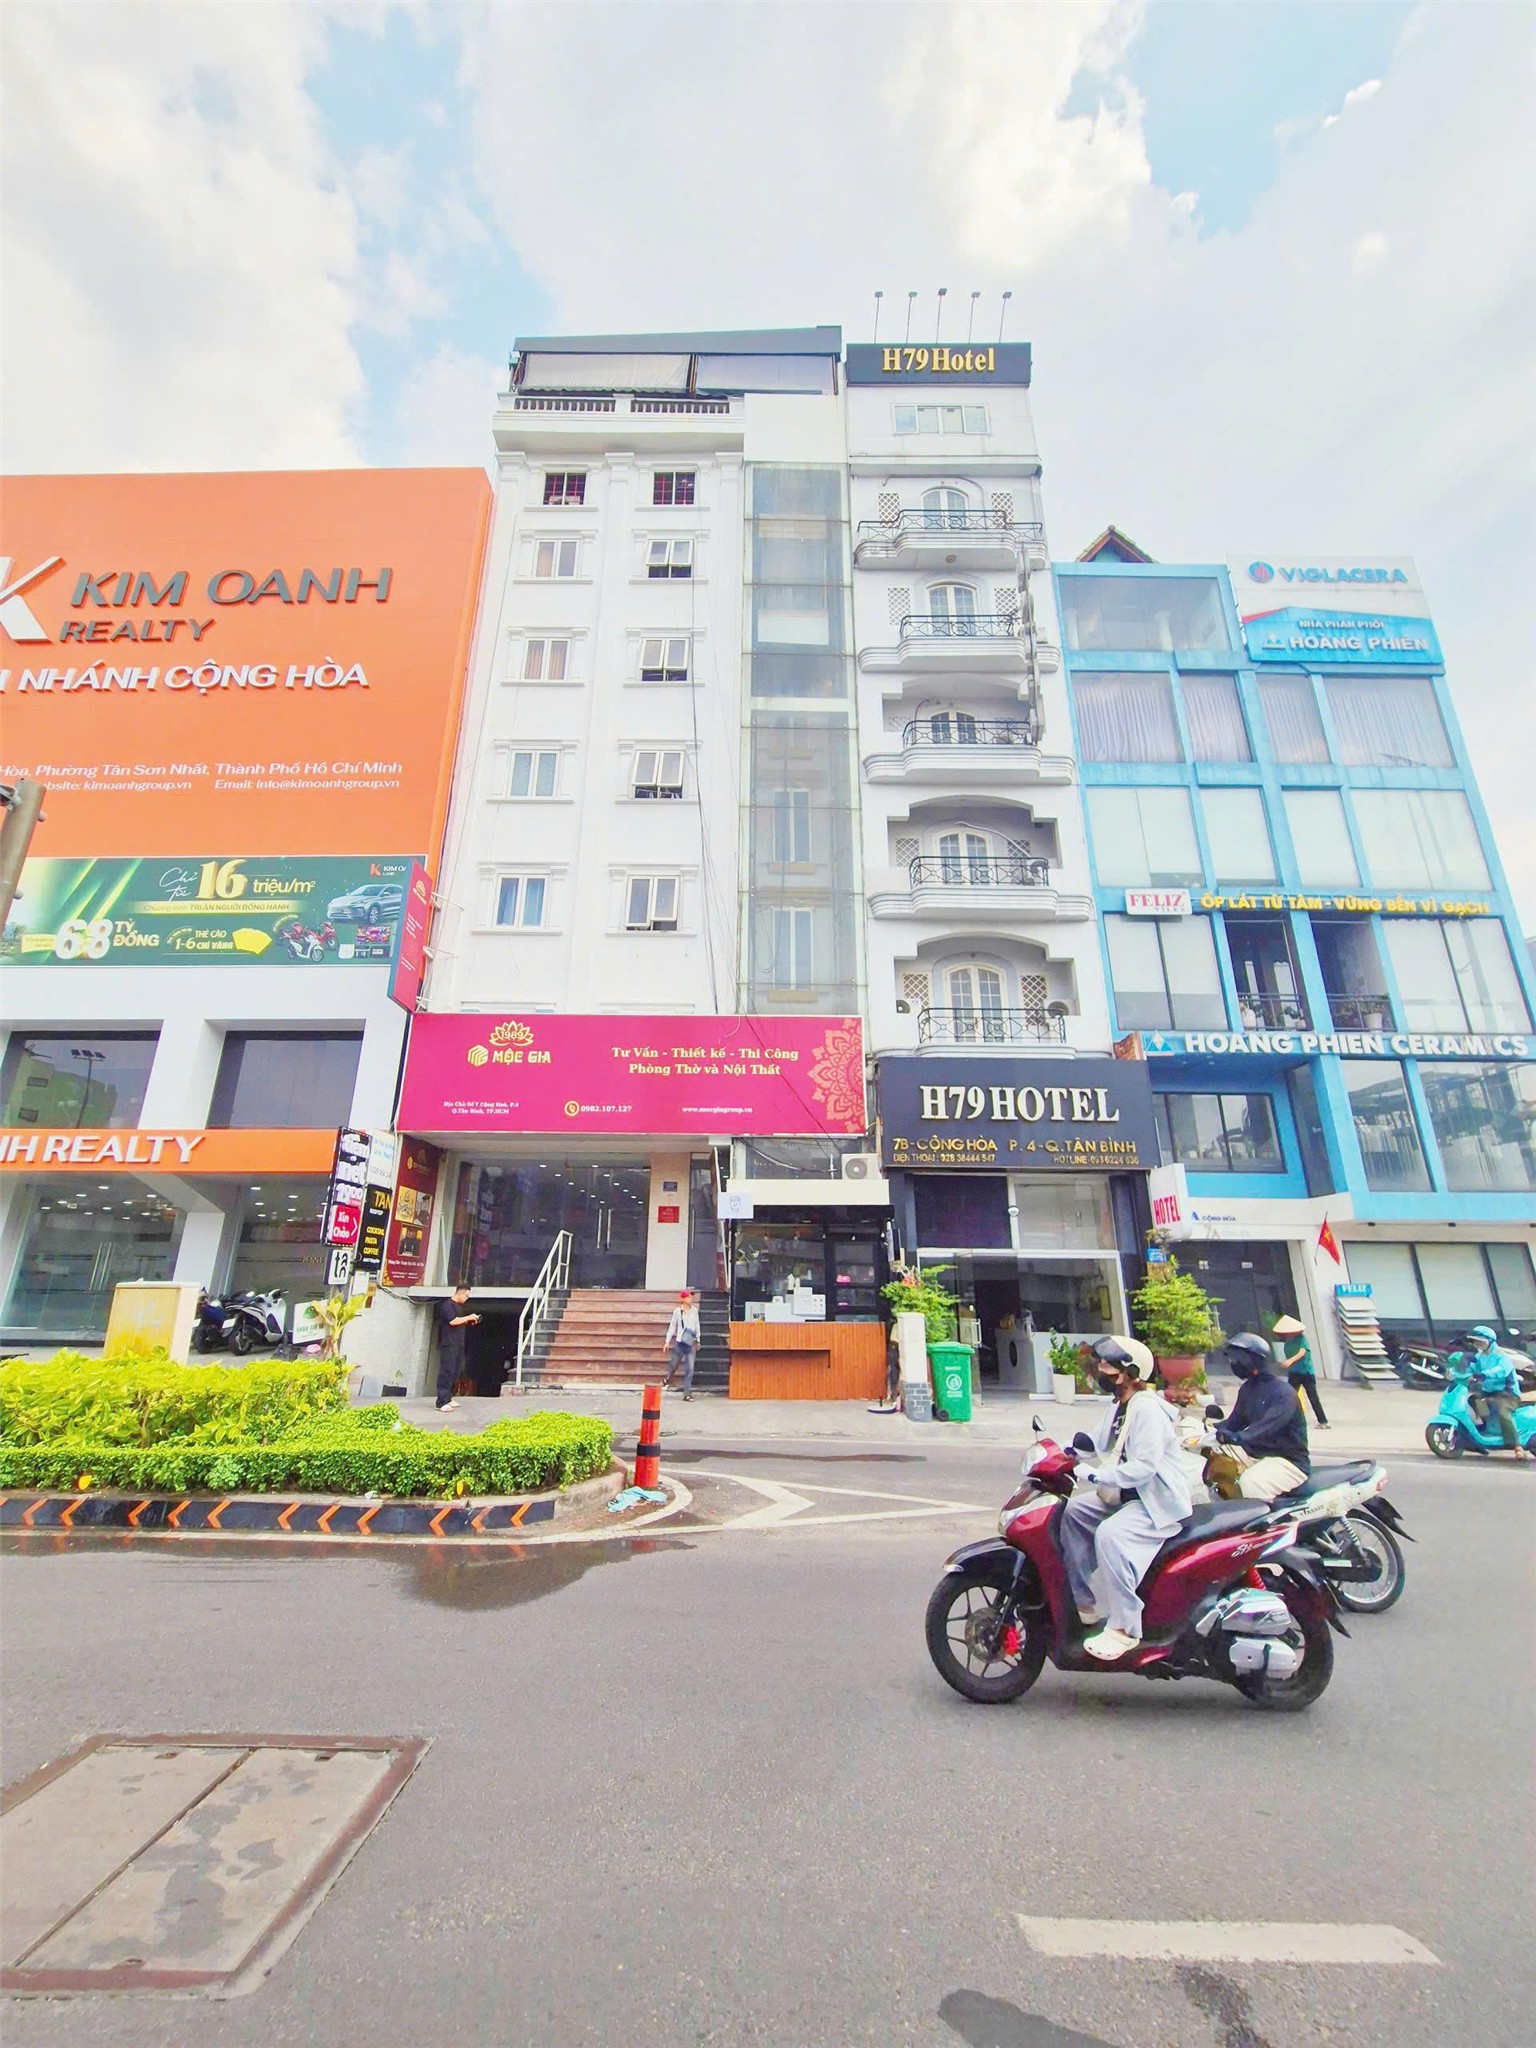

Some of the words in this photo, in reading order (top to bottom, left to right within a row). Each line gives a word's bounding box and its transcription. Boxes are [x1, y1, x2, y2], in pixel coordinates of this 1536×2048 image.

[1279, 567, 1408, 584] VIGLACERA
[71, 571, 189, 607] KIM
[207, 567, 393, 605] OANH
[59, 618, 216, 643] REALTY
[18, 658, 160, 692] NHÁNH
[164, 658, 278, 696] CỘNG
[285, 656, 370, 690] HÒA
[35, 764, 98, 779] Phường
[102, 764, 131, 776] Tân
[133, 764, 167, 776] Sơn
[169, 763, 210, 777] Nhất,
[215, 762, 265, 775] Thành
[268, 761, 301, 775] Phố
[304, 761, 328, 775] Hồ
[331, 761, 363, 775] Chí
[363, 761, 403, 774] Minh
[43, 780, 82, 791] bsite:
[84, 780, 192, 792] kimoanhgroup.vn
[214, 779, 253, 790] Email:
[256, 778, 400, 790] info@kimoanhgroup.vn
[195, 858, 248, 899] 16
[1130, 895, 1184, 907] FELIZ
[1227, 892, 1257, 909] LÁT
[1289, 893, 1323, 910] TÂM
[1442, 901, 1490, 917] GẠCH
[175, 937, 196, 950] 1-6
[1185, 1032, 1294, 1054] HOANG
[1301, 1033, 1384, 1055] PHIEN
[492, 1047, 523, 1066] MỘC
[528, 1050, 551, 1064] GIA
[612, 1047, 631, 1058] Tư
[633, 1047, 659, 1058] Vấn
[672, 1047, 706, 1059] Thiết
[710, 1046, 727, 1059] kế
[739, 1048, 760, 1059] Thi
[765, 1047, 799, 1061] Công
[629, 1063, 671, 1076] Phòng
[675, 1063, 701, 1075] Thờ
[704, 1064, 719, 1075] và
[723, 1064, 747, 1076] Nội
[751, 1064, 781, 1075] Thất
[42, 1135, 205, 1163] REALTY
[1099, 1136, 1137, 1153] BÌNH
[337, 1211, 350, 1223] Xin
[1153, 1195, 1181, 1226] HOTEL
[333, 1226, 350, 1239] Chào
[363, 1247, 379, 1256] COFFEE
